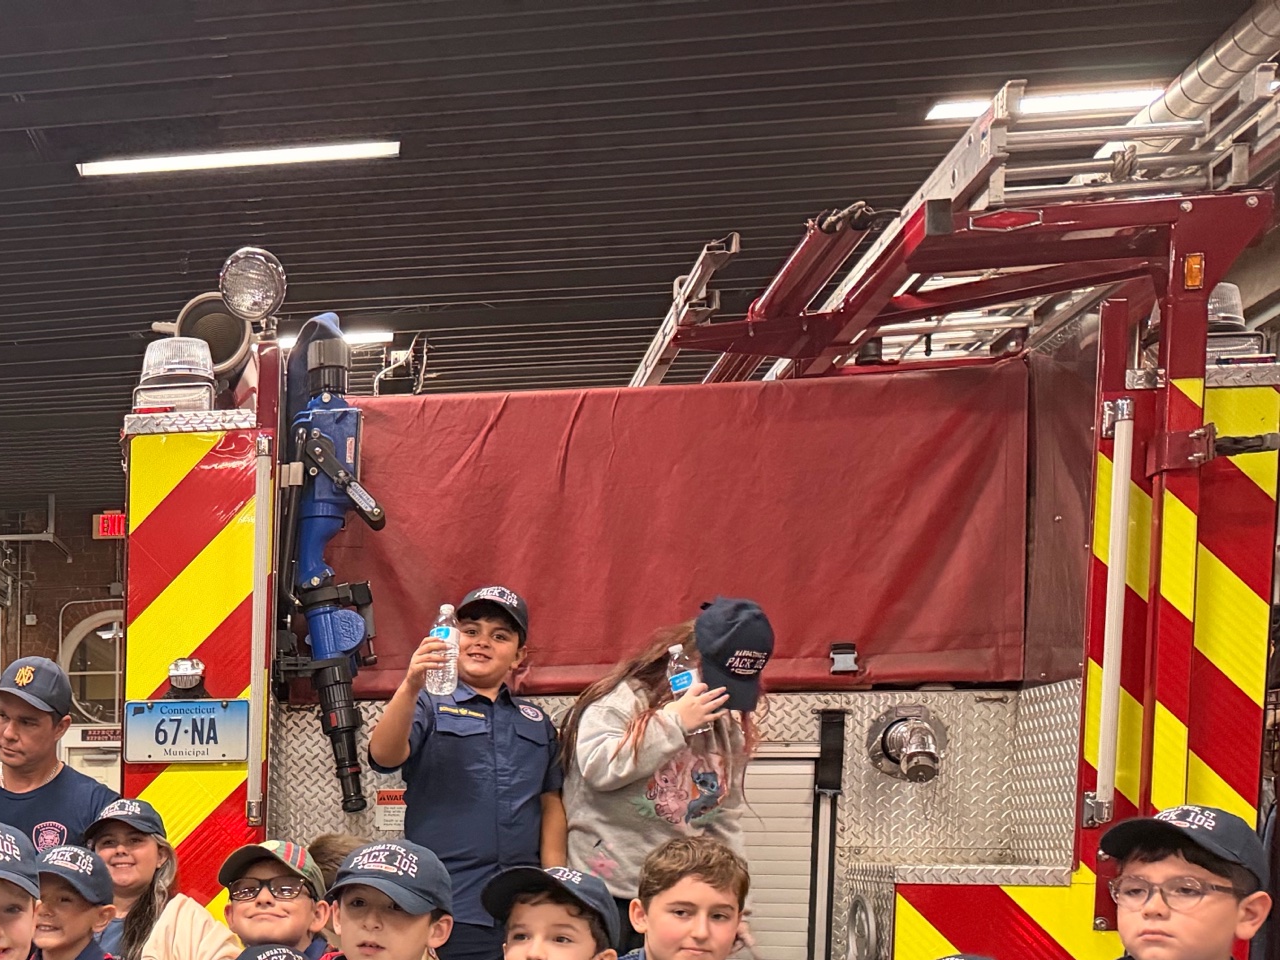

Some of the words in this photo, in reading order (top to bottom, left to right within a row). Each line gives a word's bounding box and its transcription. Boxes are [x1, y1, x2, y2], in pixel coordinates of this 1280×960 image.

[99, 514, 126, 537] EXIT
[726, 657, 753, 669] PACK
[160, 704, 216, 715] Connecticut
[163, 748, 210, 758] Municipal
[1186, 812, 1216, 831] 102
[5, 832, 17, 845] CT
[43, 850, 72, 863] PACK
[77, 857, 94, 876] 102
[349, 851, 390, 869] PACK
[393, 854, 418, 878] 102
